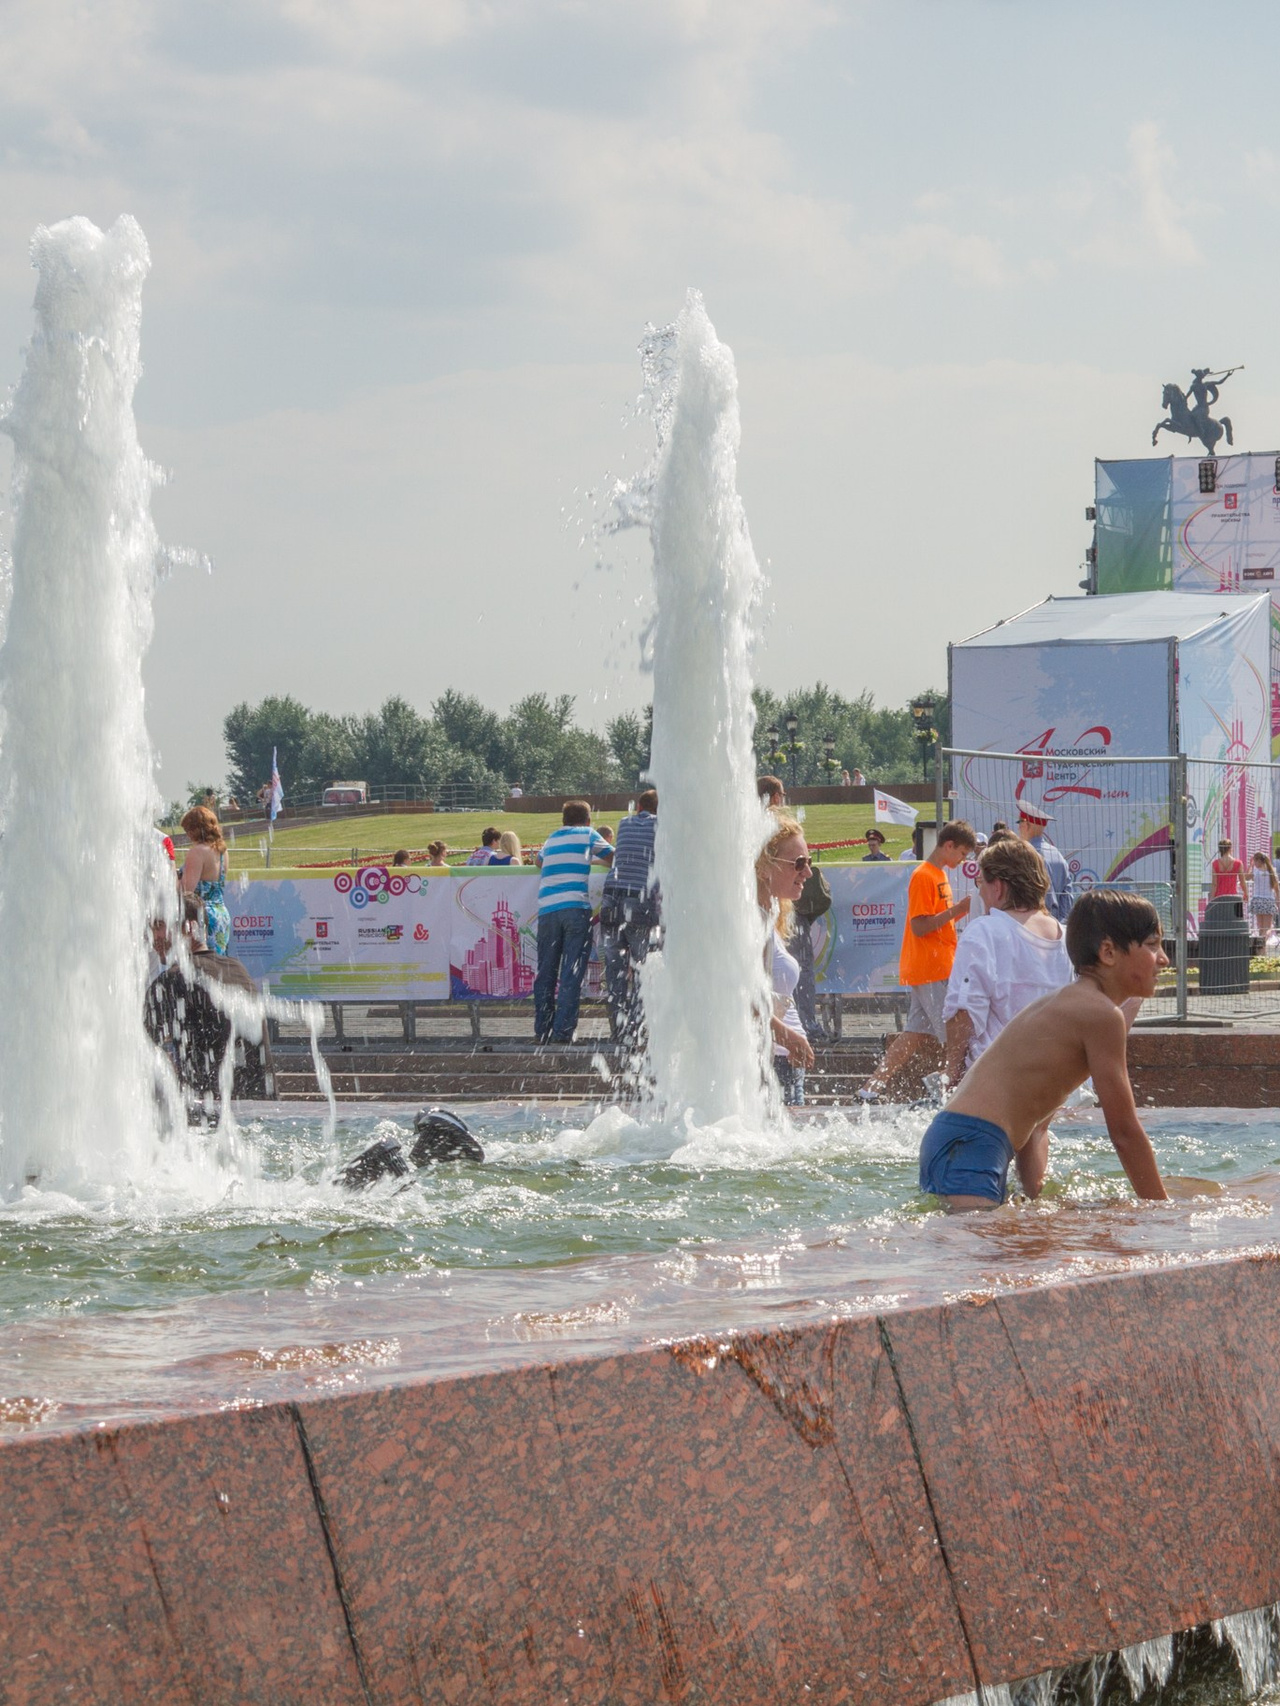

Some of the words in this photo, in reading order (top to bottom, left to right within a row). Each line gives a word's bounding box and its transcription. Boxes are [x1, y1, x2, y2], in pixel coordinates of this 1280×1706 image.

[1046, 747, 1107, 756] Московский
[1047, 771, 1077, 782] Центр
[852, 903, 895, 916] СОВЕТ
[232, 915, 274, 928] СОВЕТ
[852, 917, 896, 931] проректоров
[232, 929, 275, 941] проректоров
